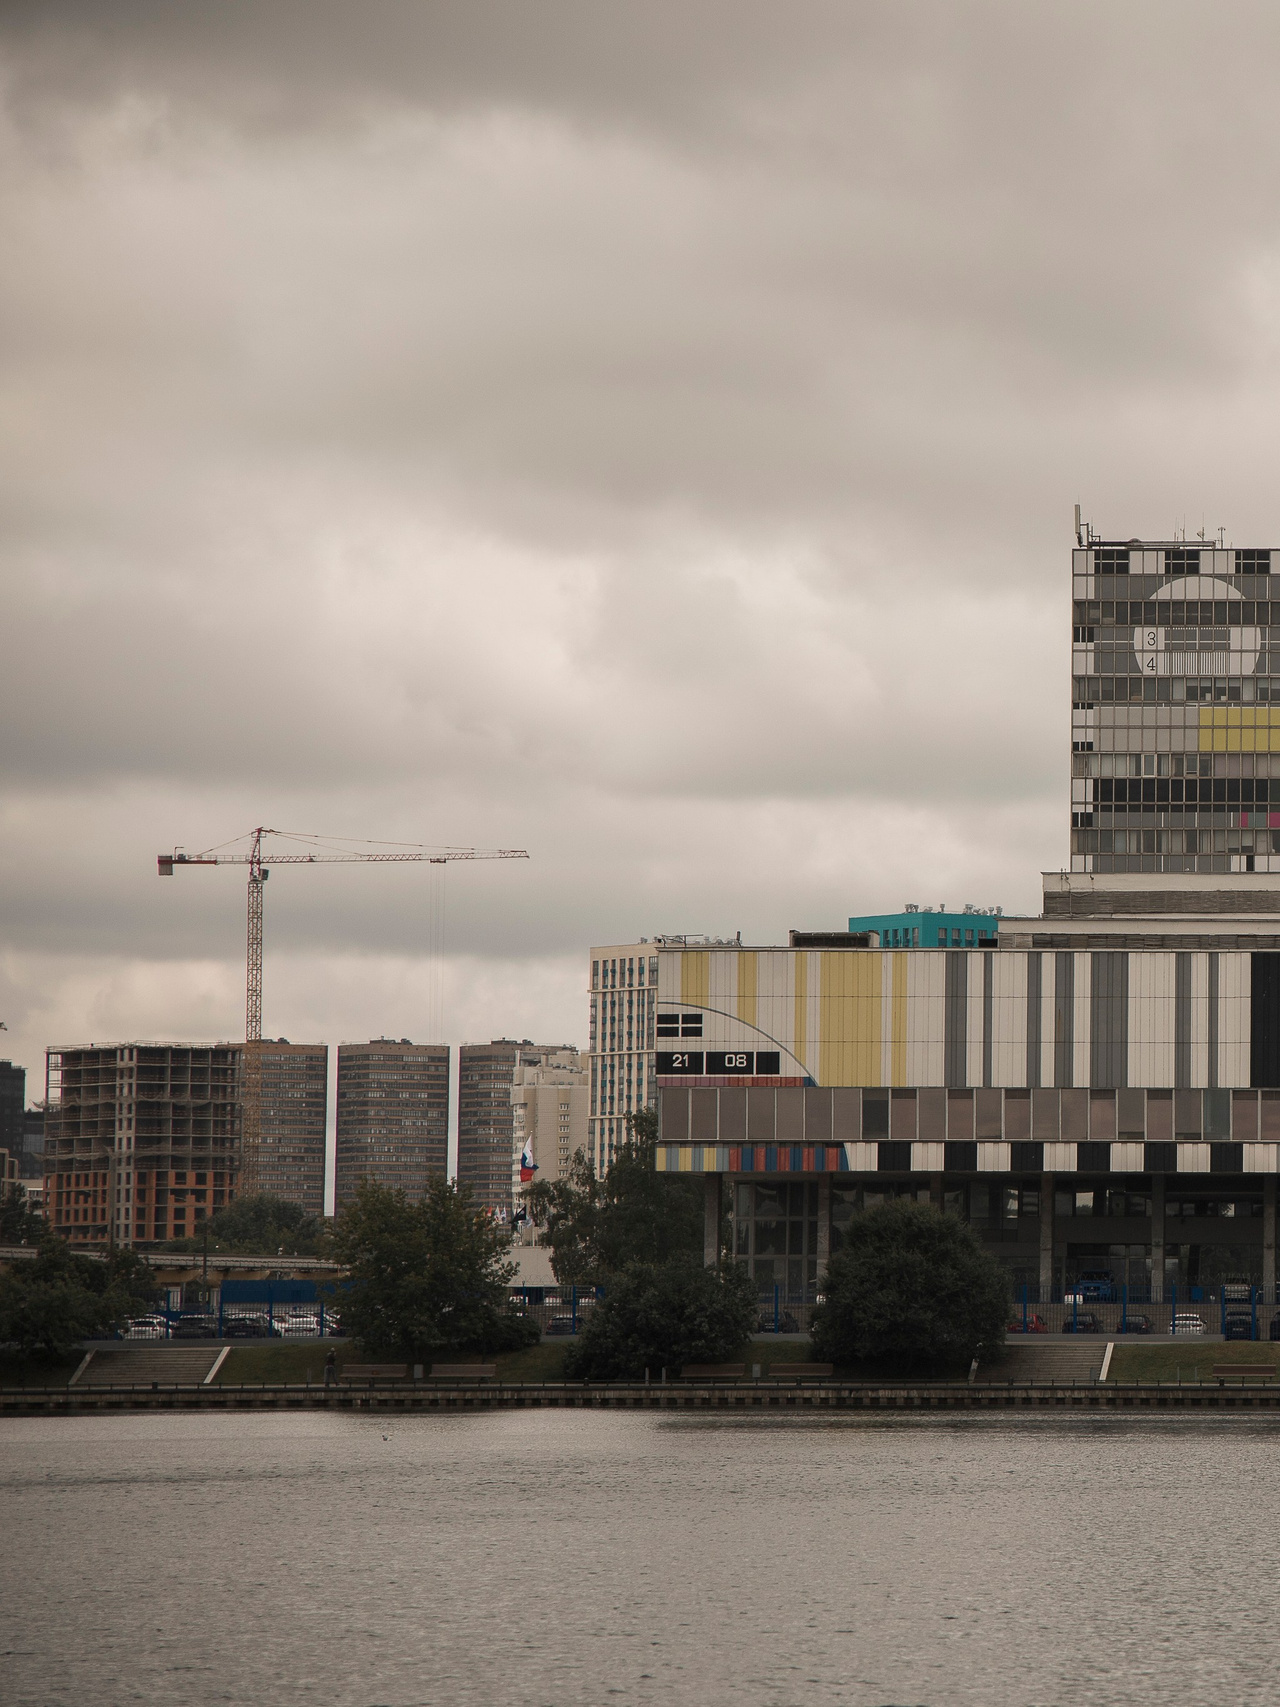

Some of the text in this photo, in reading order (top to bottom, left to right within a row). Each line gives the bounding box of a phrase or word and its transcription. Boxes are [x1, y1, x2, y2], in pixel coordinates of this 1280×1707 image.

[1147, 631, 1156, 646] 3
[1146, 657, 1156, 671] 4
[672, 1053, 747, 1067] 21 08
